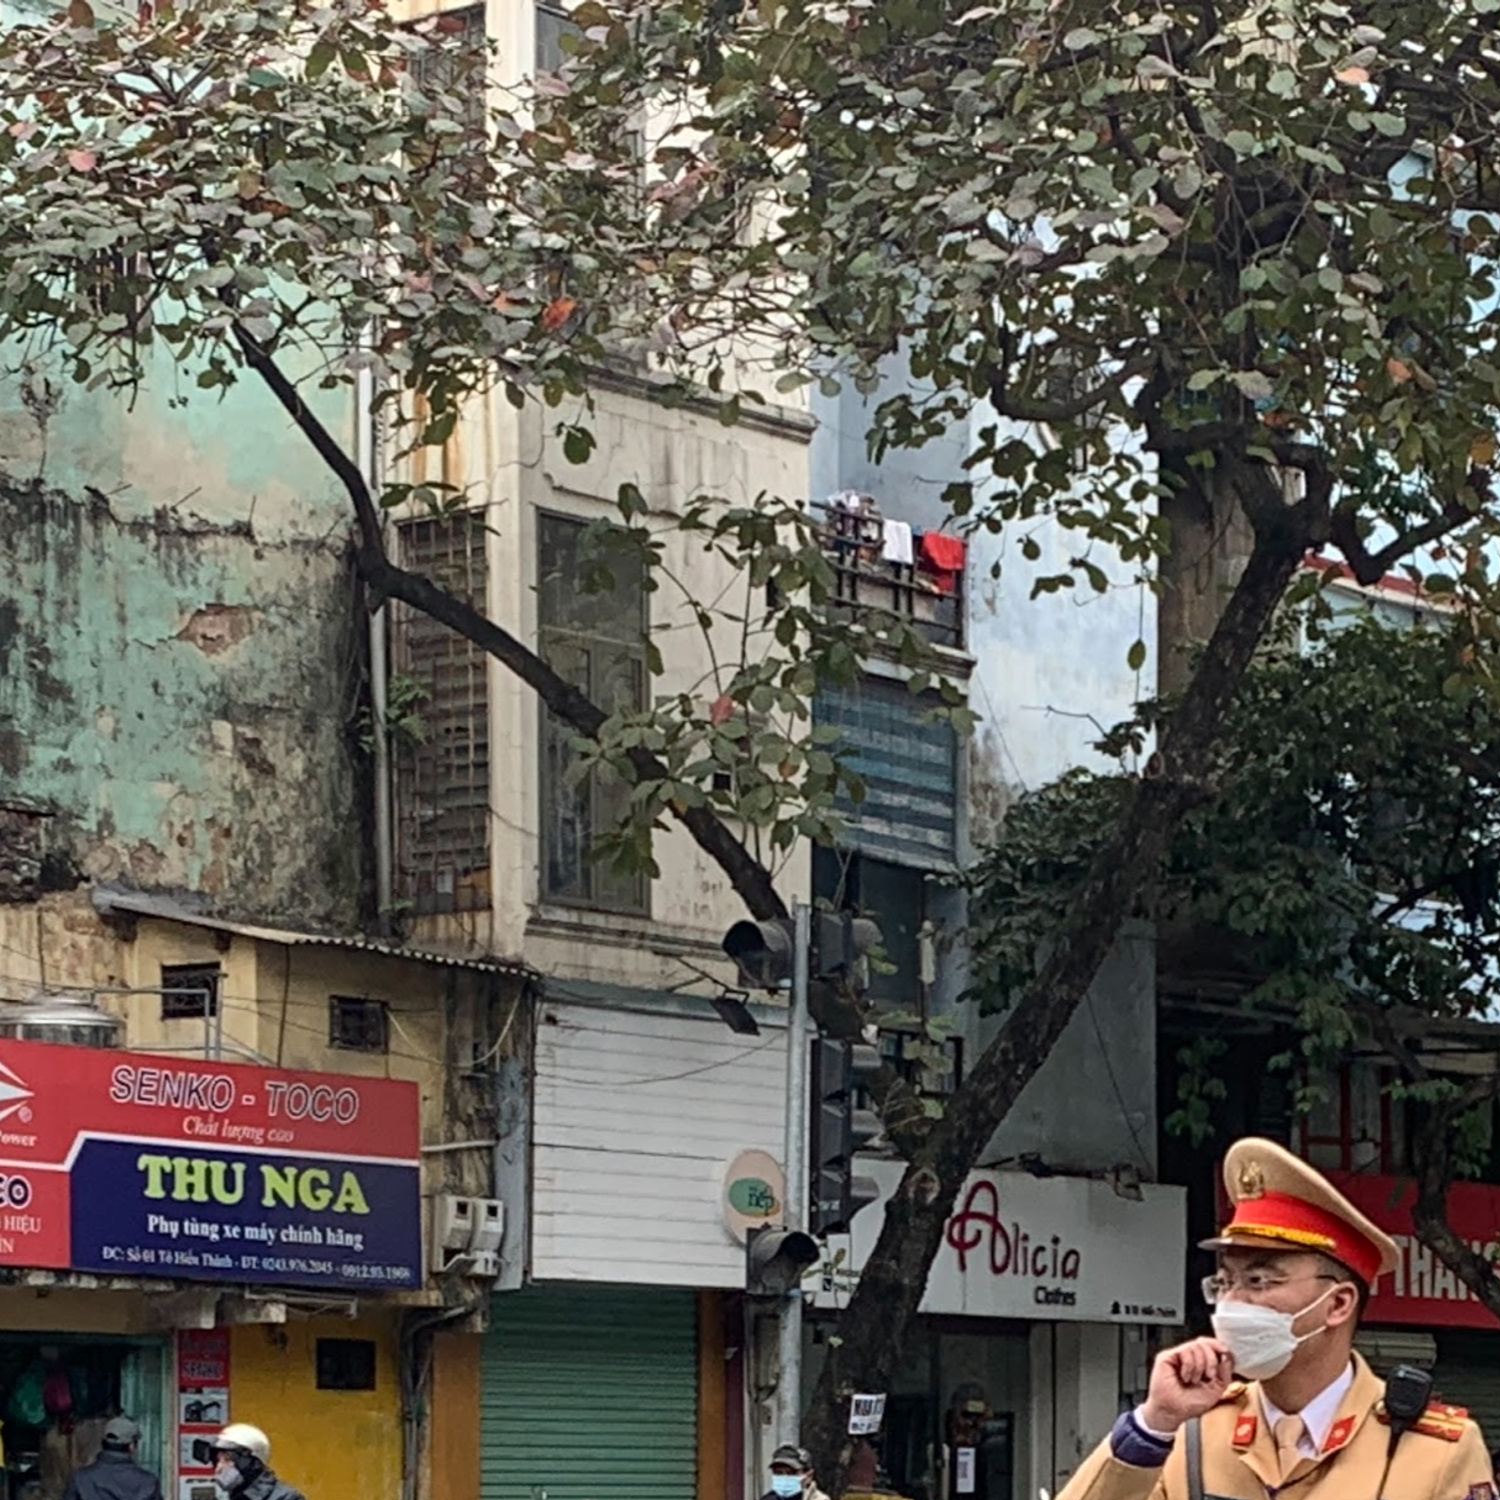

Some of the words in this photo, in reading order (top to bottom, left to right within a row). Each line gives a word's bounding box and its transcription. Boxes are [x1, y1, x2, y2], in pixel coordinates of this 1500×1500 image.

[109, 1064, 236, 1113] SENKO
[265, 1080, 359, 1125] TOCO
[182, 1113, 218, 1136] Chất
[267, 1128, 295, 1143] cao
[137, 1153, 247, 1205] THU
[259, 1163, 371, 1215] NGA
[147, 1213, 180, 1239] Phụ
[183, 1216, 221, 1241] tùng
[222, 1224, 241, 1239] xe
[243, 1222, 276, 1246] máy
[280, 1224, 323, 1244] chính
[325, 1227, 365, 1251] hãng
[946, 1180, 1081, 1280] Alicia
